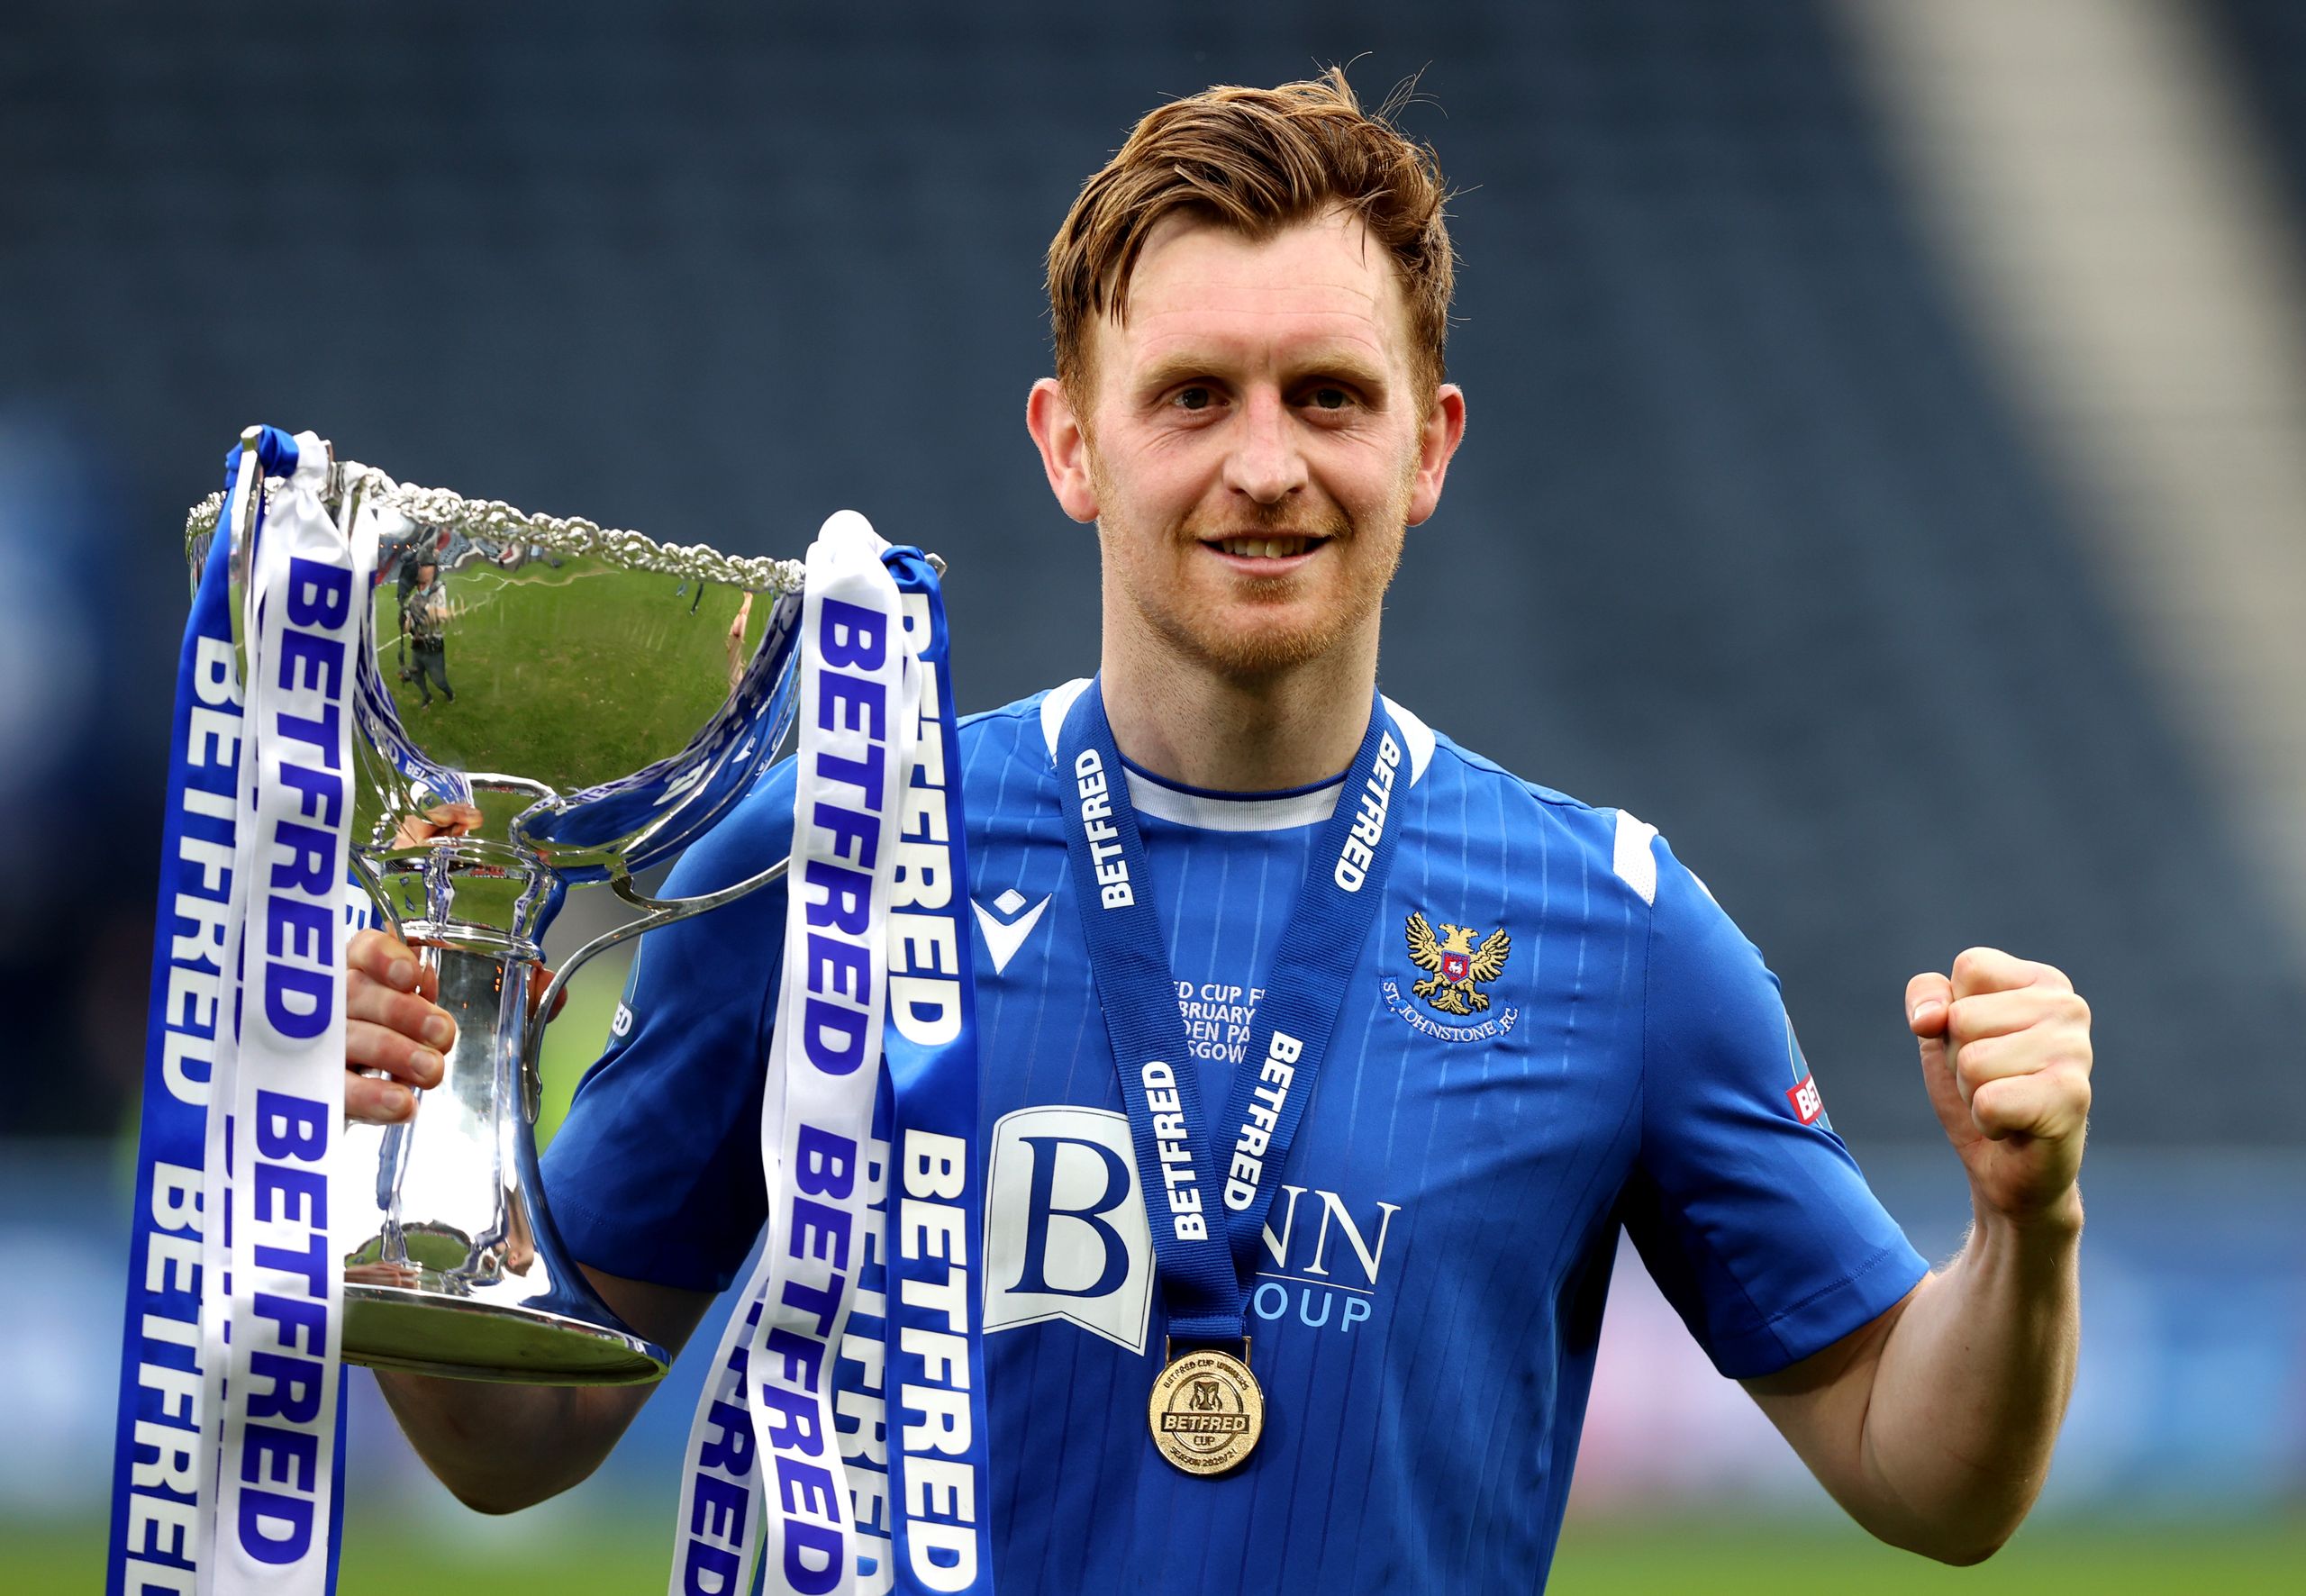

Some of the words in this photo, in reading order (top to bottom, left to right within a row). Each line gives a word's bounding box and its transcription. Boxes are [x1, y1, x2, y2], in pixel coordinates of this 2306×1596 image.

[265, 556, 351, 1038] BETFRED
[804, 597, 887, 1075] BETFRED
[886, 594, 962, 1046] TFRED
[1075, 748, 1135, 910] BETFRED
[1334, 730, 1400, 892] BETFRED
[1201, 984, 1242, 1003] CUP
[1141, 1060, 1208, 1239] BETFRED
[1224, 1030, 1303, 1211] BETFRED
[1005, 1136, 1130, 1298] B
[238, 1089, 328, 1565] BETFRED
[763, 1124, 857, 1595] BETFRED
[901, 1129, 977, 1592] BETFRED
[1253, 1283, 1372, 1333] OUP
[1164, 1416, 1246, 1430] BETFRED
[1194, 1436, 1215, 1446] CUP
